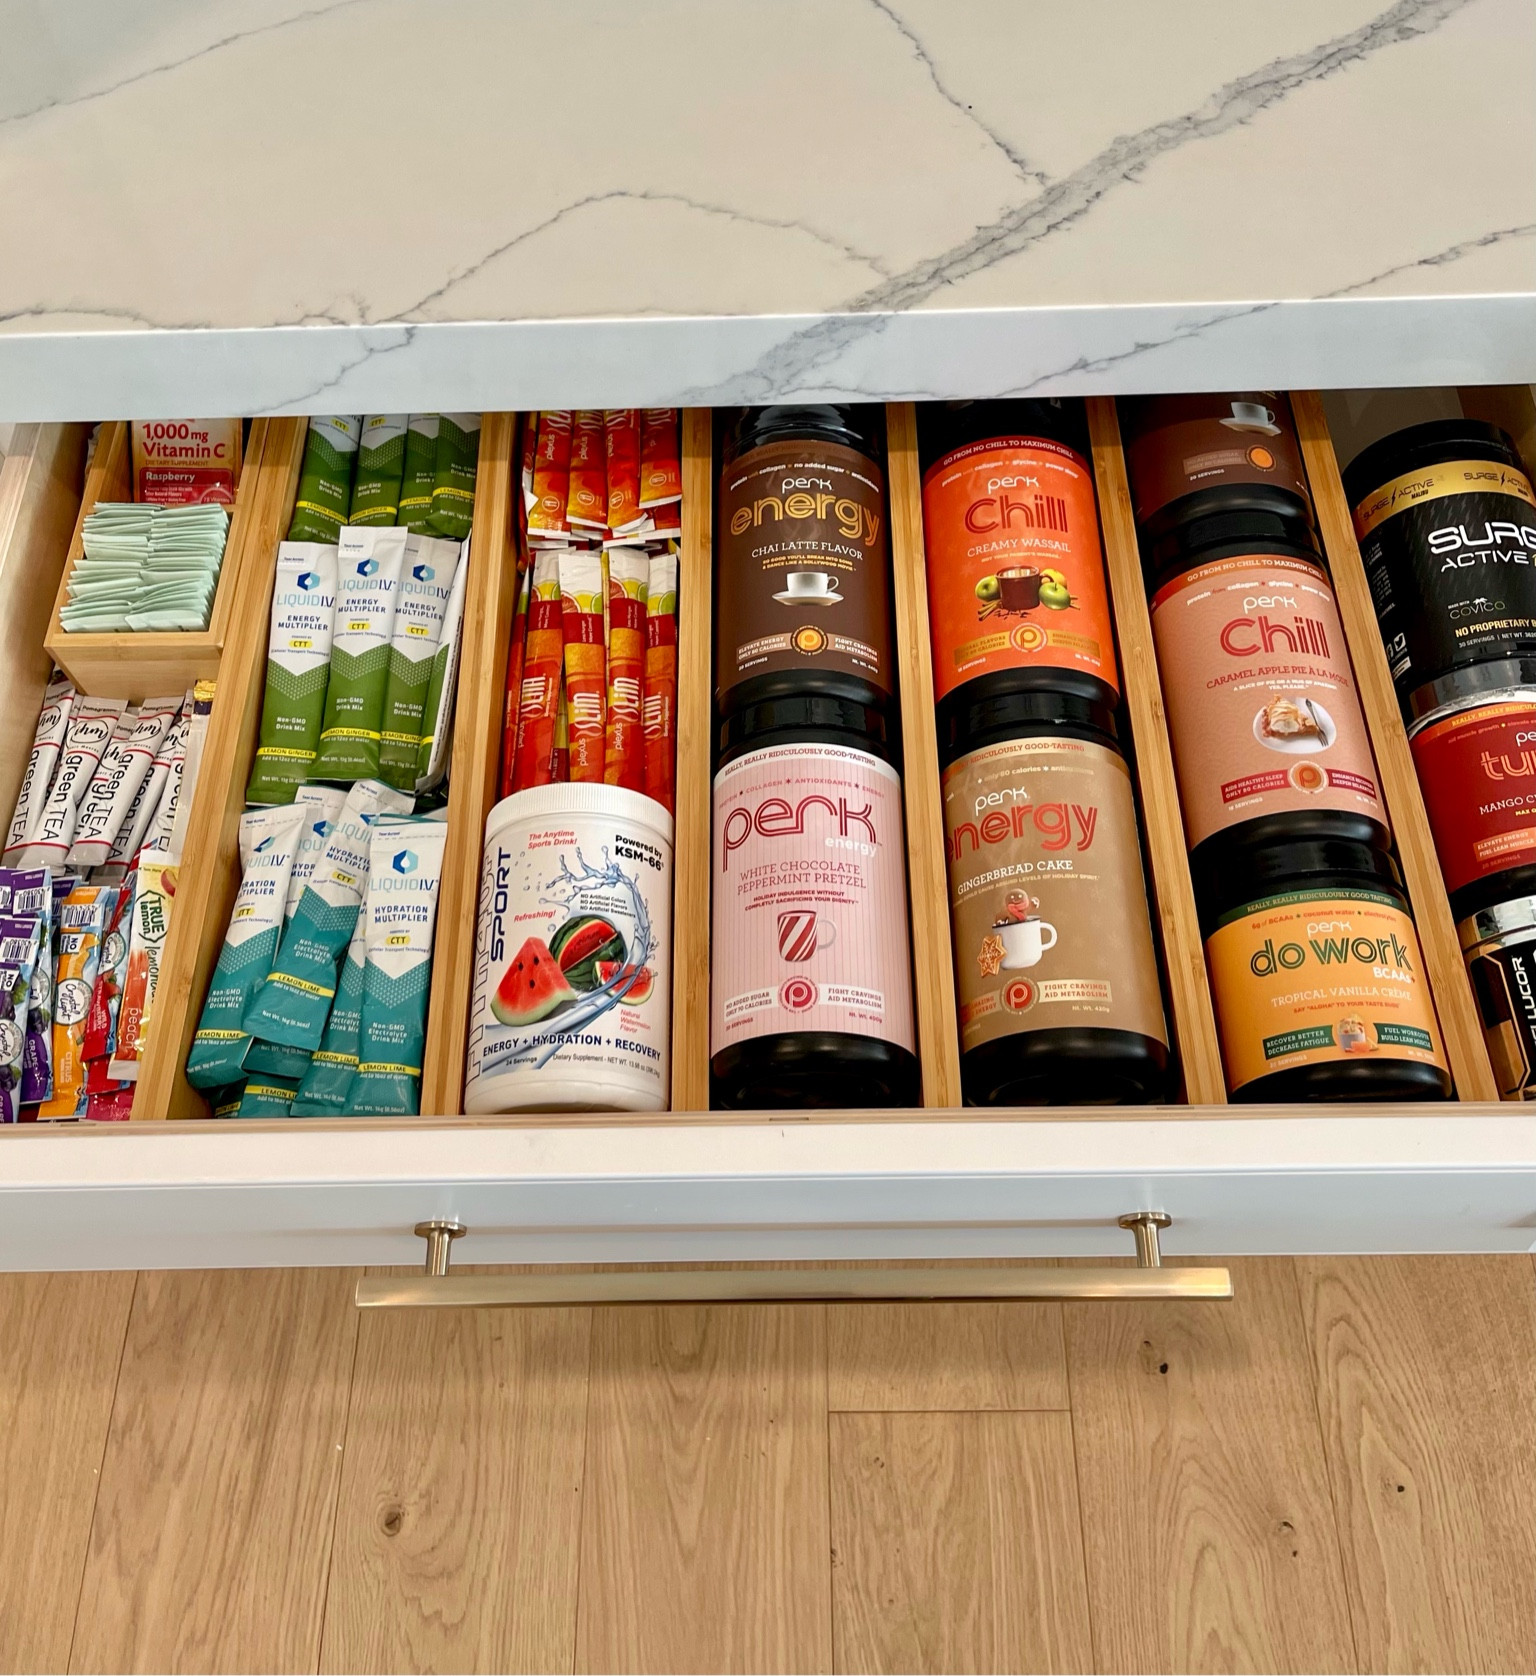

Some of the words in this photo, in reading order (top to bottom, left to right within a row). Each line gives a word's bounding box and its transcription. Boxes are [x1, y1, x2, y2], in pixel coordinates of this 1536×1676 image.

[143, 423, 189, 440] 1,000
[191, 432, 209, 443] mg
[143, 442, 210, 458] Vitamin
[214, 443, 225, 458] C
[944, 457, 952, 465] GO
[953, 448, 972, 460] FROM
[986, 441, 1007, 449] CHILL
[1021, 440, 1056, 450] MAXIMUM
[1056, 447, 1073, 459] CHILL
[146, 472, 195, 483] Raspberry
[782, 478, 832, 494] perk
[988, 475, 1039, 494] perk
[1363, 497, 1390, 520] SURGE
[1399, 479, 1434, 498] ACTIVE
[1412, 489, 1429, 499] MALIBU
[731, 492, 880, 546] energy
[965, 494, 1068, 534] Chill
[1428, 520, 1536, 554] SURG
[751, 544, 779, 558] CHAI
[782, 541, 818, 551] LATTE
[821, 542, 863, 560] FLAVOR
[967, 539, 1018, 558] CREAMY
[1022, 538, 1071, 552] WASSAIL
[1441, 550, 1529, 572] ACTIVE
[1187, 573, 1199, 582] GO
[1199, 566, 1221, 577] FROM
[1237, 560, 1260, 568] CHILL
[1274, 560, 1308, 571] MAXIMUM
[1308, 567, 1323, 580] CHILL
[337, 579, 378, 592] LIQUID
[277, 594, 319, 607] LIQUID
[338, 606, 386, 614] MULTIPLIER
[404, 602, 437, 612] ENERGY
[1243, 595, 1297, 614] perk
[1450, 601, 1506, 619] COVICO
[288, 615, 320, 623] ENERGY
[395, 608, 443, 621] MULTIPLIER
[278, 622, 328, 631] MULTIPLIER
[1455, 627, 1468, 638] NO
[1470, 619, 1530, 634] PROPRIETARY
[1220, 616, 1330, 659] Chill
[1207, 670, 1255, 690] CARAMEL
[1258, 666, 1290, 676] APPLE
[1293, 666, 1307, 675] PIE
[1317, 669, 1327, 678] LA
[294, 724, 305, 732] Mix
[614, 722, 623, 750] plexus
[289, 749, 313, 757] GINGER
[579, 738, 588, 766] plexus
[970, 745, 1023, 764] RIDICULOUSLY
[1025, 743, 1085, 752] GOOD-TASTING
[725, 762, 743, 776] REALLY,
[744, 753, 767, 766] REALLY
[769, 749, 823, 759] RIDICULOUSLY
[824, 749, 875, 766] GOOD-TASTING
[1012, 766, 1041, 775] calories
[19, 750, 40, 805] green
[66, 755, 83, 802] green
[103, 753, 134, 802] green
[1224, 785, 1238, 793] AIDS
[1239, 777, 1264, 789] HEALTHY
[1266, 773, 1283, 781] SLEEP
[975, 786, 1028, 816] perk
[1480, 797, 1523, 815] MANGO
[10, 809, 28, 846] TEA
[41, 808, 67, 841] TEA
[85, 805, 113, 839] TEA
[723, 795, 876, 873] perk
[1477, 838, 1502, 850] ELEVATE
[1504, 832, 1528, 842] ENERGY
[528, 841, 551, 849] Sports
[615, 835, 653, 853] Powered
[654, 849, 663, 859] by
[825, 836, 877, 857] energy
[1494, 844, 1509, 854] LEAN
[615, 845, 661, 872] KSM-66
[740, 863, 776, 881] WHITE
[780, 861, 860, 875] CHOCOLATE
[957, 863, 1034, 895] GINGERBREAD
[1036, 860, 1073, 871] CAKE
[370, 878, 419, 891] LIQUID
[737, 873, 810, 895] PEPPERMINT
[814, 873, 866, 888] PRETZEL
[491, 847, 511, 961] SPORT
[754, 892, 776, 902] HOLIDAY
[149, 897, 165, 933] TRUE
[375, 906, 428, 914] HYDRATION
[375, 915, 428, 923] MULTIPLIER
[514, 910, 556, 923] Refreshing!
[1307, 921, 1352, 937] perk
[1251, 939, 1305, 977] do
[1310, 933, 1412, 972] work
[5, 975, 13, 989] NO
[278, 975, 303, 988] LEMON
[304, 981, 320, 992] LIME
[842, 997, 882, 1009] METABOLISM
[851, 990, 881, 1001] CRAVINGS
[1272, 990, 1327, 1008] TROPICAL
[1329, 987, 1379, 997] VANILLA
[620, 1009, 640, 1019] Natural
[620, 1017, 650, 1030] Watermelon
[620, 1024, 638, 1033] Flavor
[1384, 1026, 1399, 1034] FUEL
[483, 1038, 519, 1057] ENERGY
[532, 1035, 601, 1046] HYDRATION
[615, 1039, 660, 1060] RECOVERY
[1266, 1034, 1296, 1048] RECOVER
[1298, 1030, 1324, 1040] BETTER
[1268, 1042, 1299, 1055] DECREASE
[1300, 1037, 1330, 1049] FATIGUE
[28, 1039, 37, 1070] GRAPE
